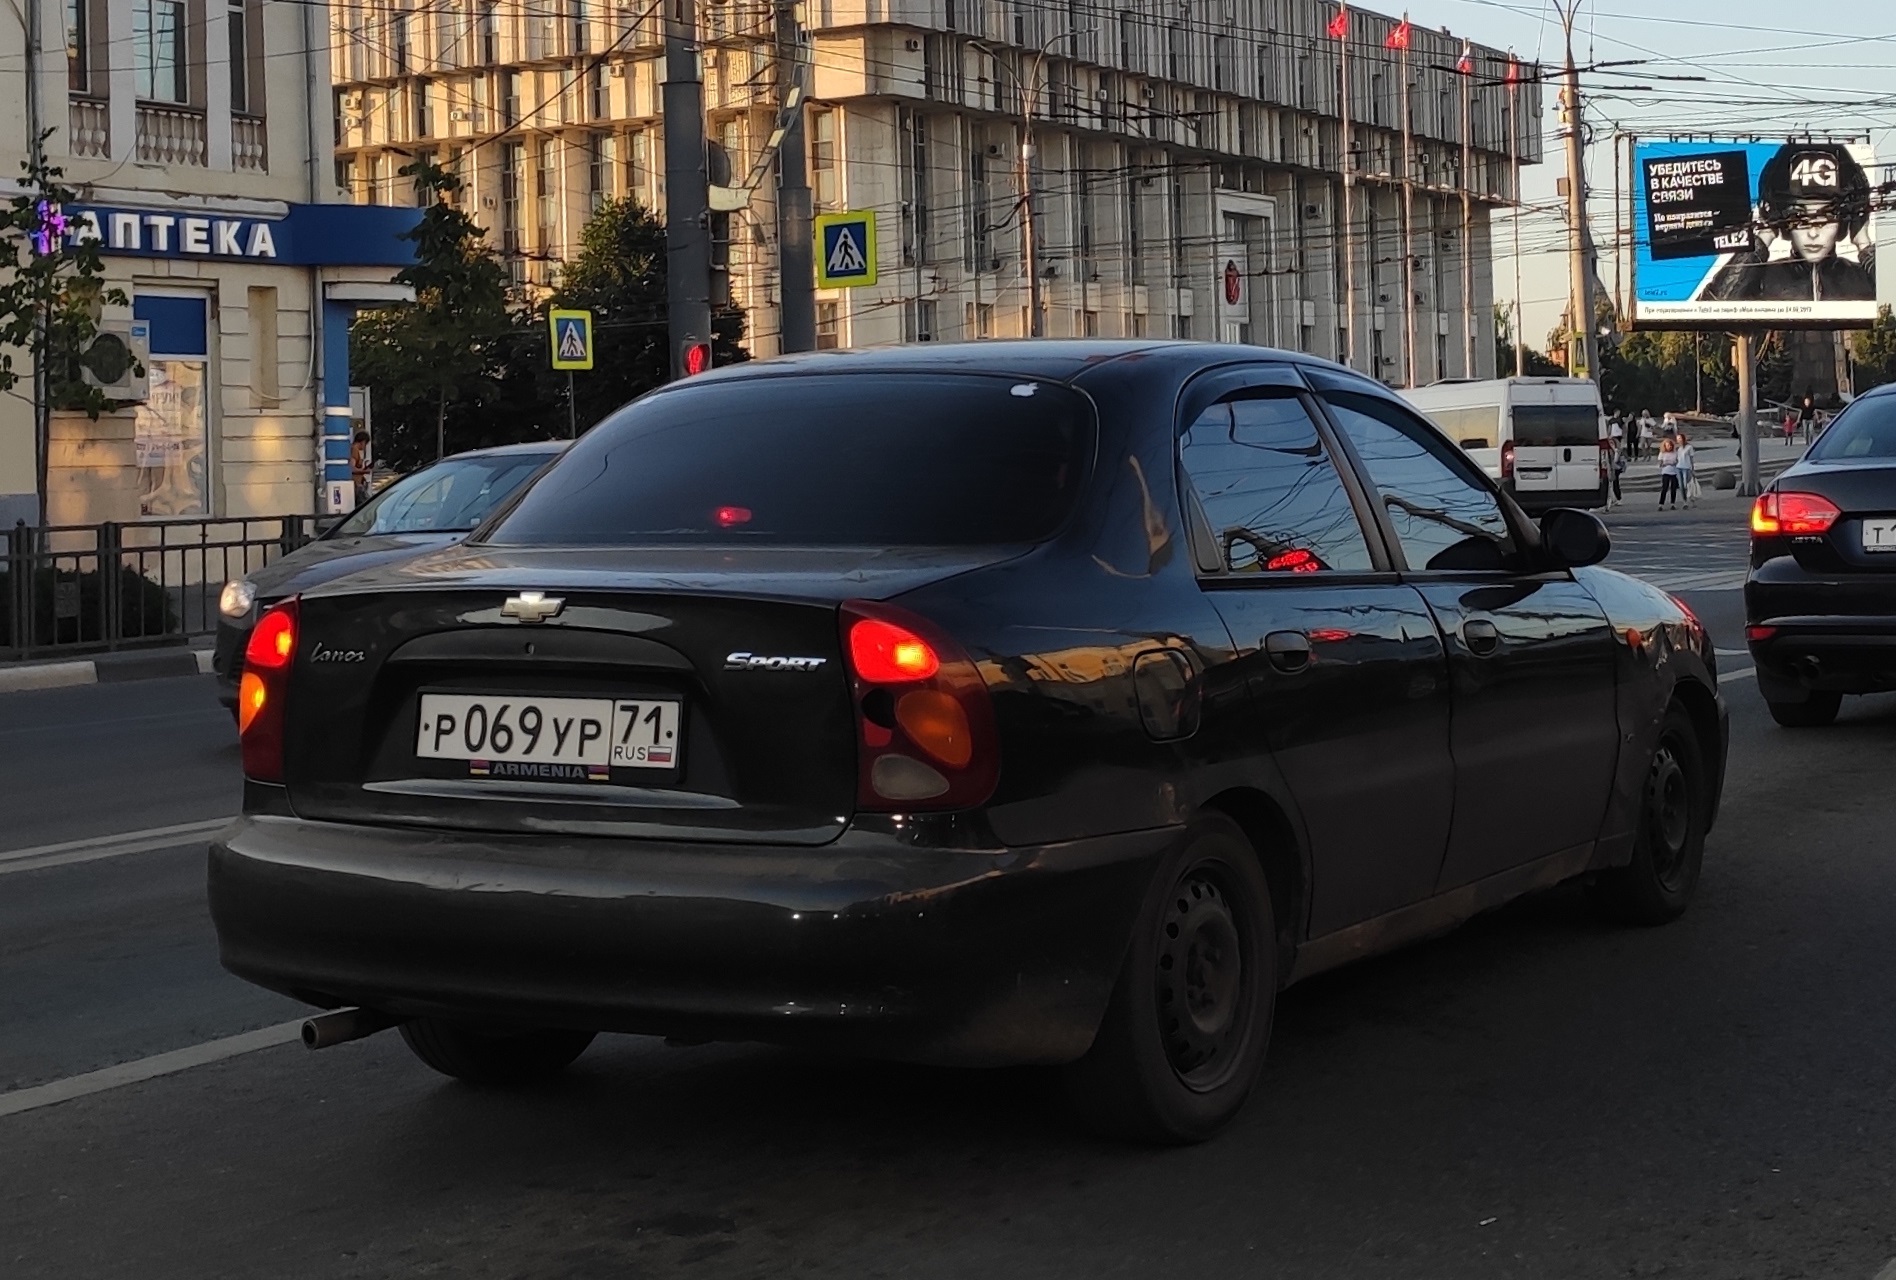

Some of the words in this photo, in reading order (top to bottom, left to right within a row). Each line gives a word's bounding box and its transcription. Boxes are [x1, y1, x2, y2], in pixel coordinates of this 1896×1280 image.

[1649, 159, 1722, 177] УБЕДИТЕСЬ
[1791, 158, 1836, 187] 4G
[1650, 178, 1660, 190] В
[1661, 172, 1724, 189] КАЧЕСТВЕ
[1651, 188, 1694, 204] СВЯЗИ
[69, 210, 277, 258] АПТЕКА
[1713, 230, 1750, 250] TELE2
[310, 642, 366, 663] Lanos
[723, 652, 827, 671] SPORT
[620, 705, 662, 745] 71
[613, 745, 646, 761] RUS
[493, 763, 586, 779] ARMENIA
